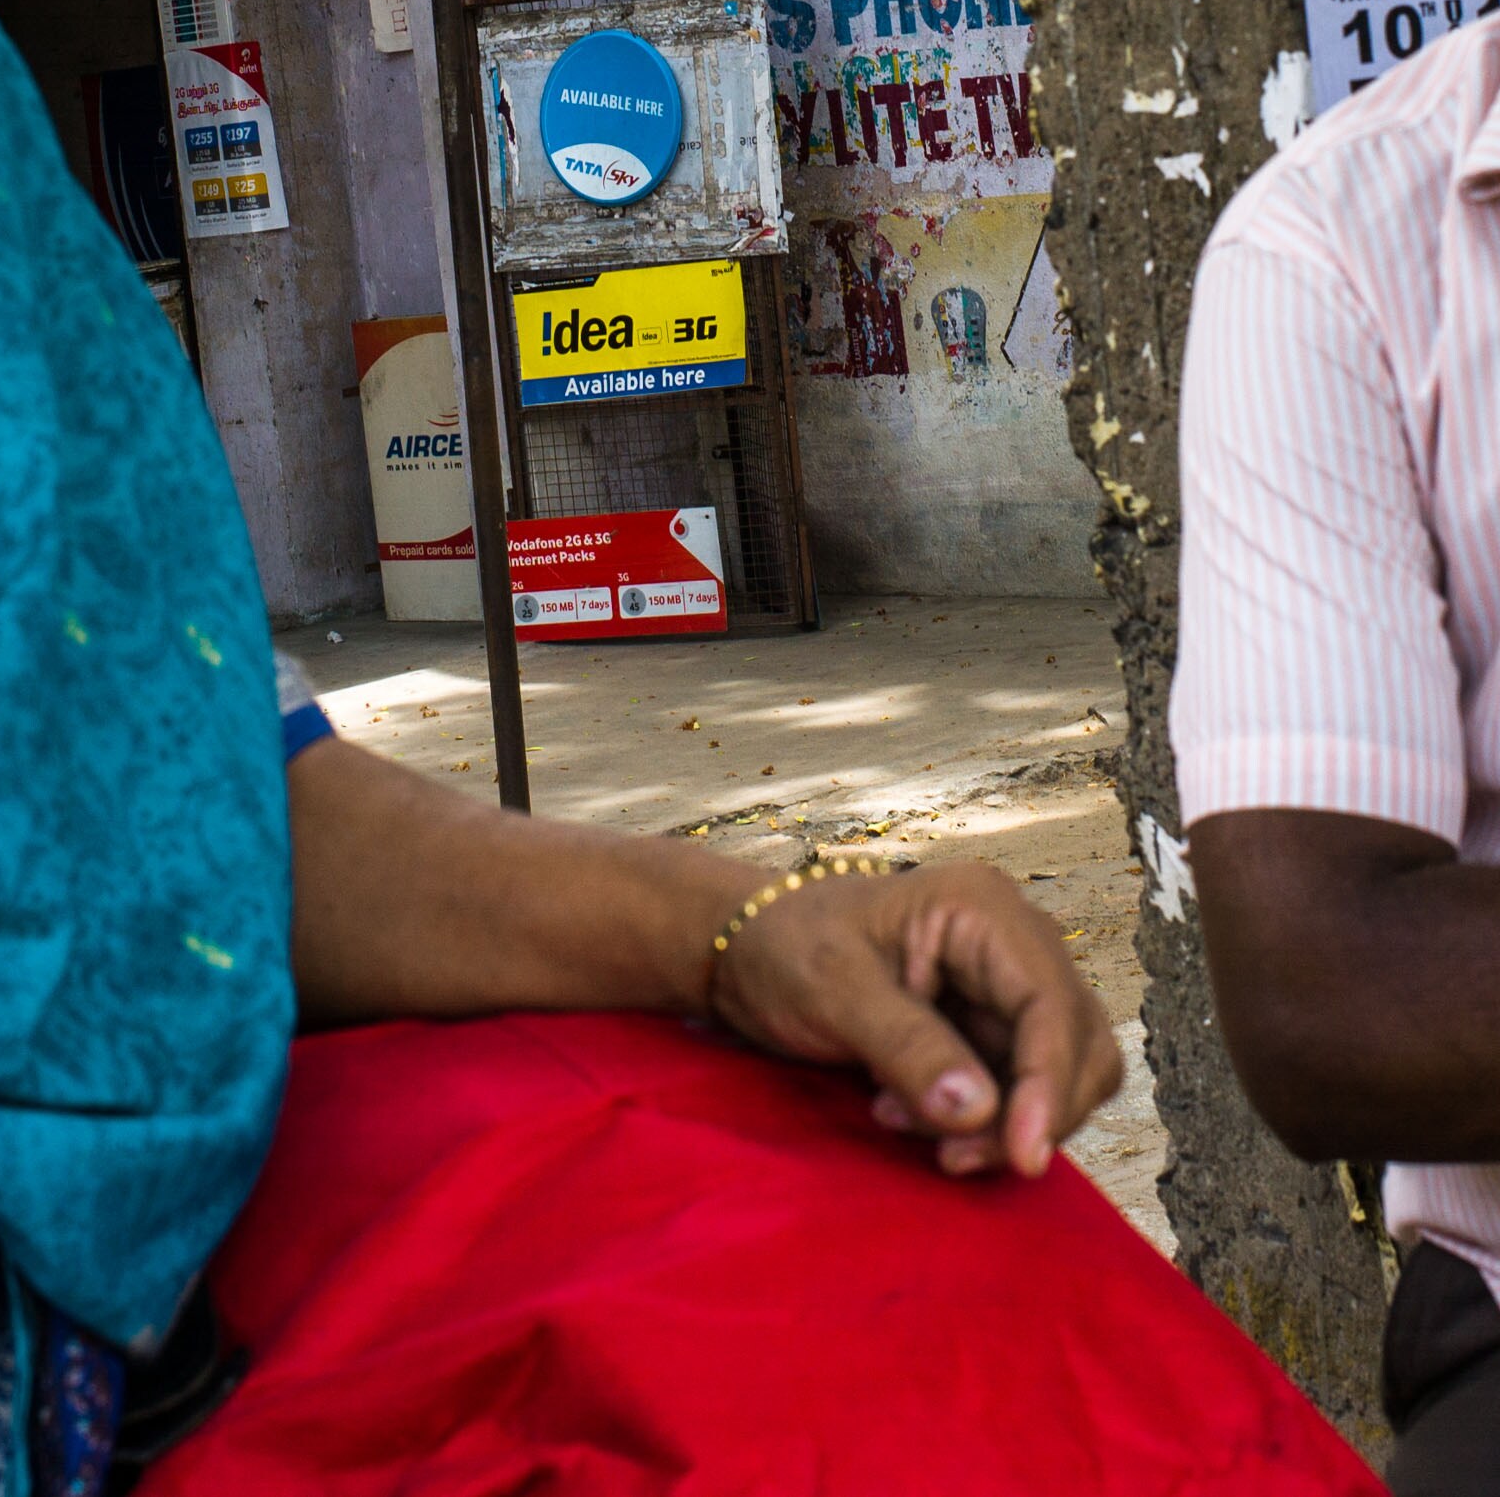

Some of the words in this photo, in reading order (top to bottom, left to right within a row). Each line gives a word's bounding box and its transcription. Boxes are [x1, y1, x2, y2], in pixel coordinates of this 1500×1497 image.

[561, 89, 632, 111] AVAILABLE
[635, 99, 664, 116] HERE
[565, 157, 603, 177] TATA
[674, 315, 718, 343] 3G
[565, 370, 655, 397] Available
[662, 366, 705, 388] here
[387, 462, 420, 472] makes
[565, 533, 582, 547] 2G
[584, 533, 594, 546] &
[595, 532, 612, 545] 3G
[390, 544, 425, 558] Prepaid
[426, 545, 453, 556] cards
[455, 544, 475, 555] sold
[559, 550, 596, 564] Packs
[617, 572, 630, 582] 3G
[512, 581, 524, 590] 2G
[541, 603, 558, 613] 150
[559, 602, 574, 612] MB
[588, 600, 610, 611] days
[648, 596, 665, 607] 150
[666, 595, 682, 605] MB
[696, 593, 718, 605] days
